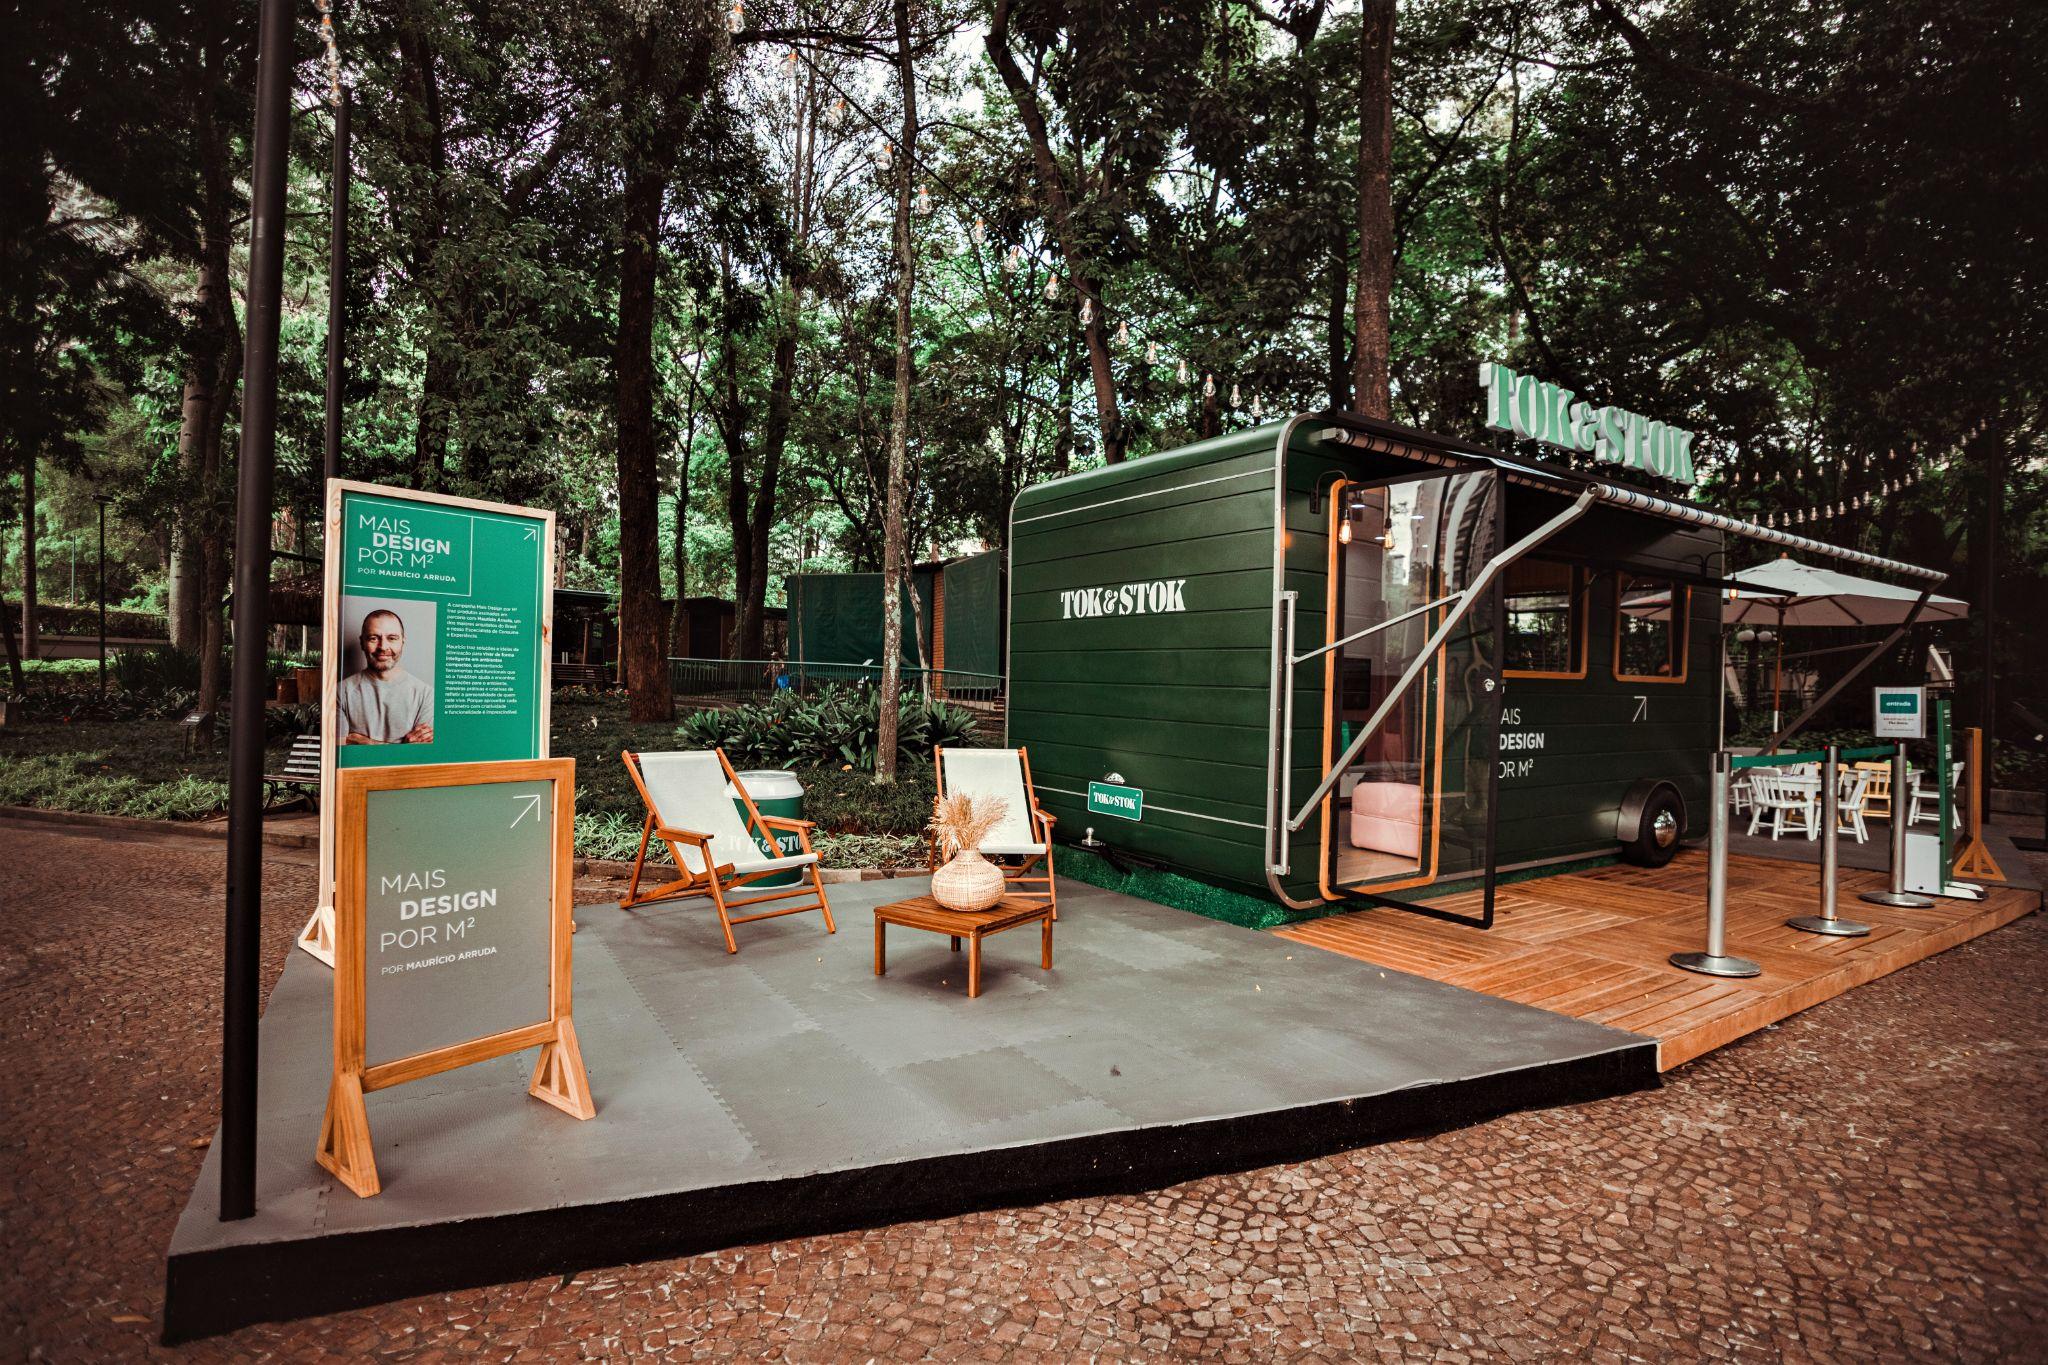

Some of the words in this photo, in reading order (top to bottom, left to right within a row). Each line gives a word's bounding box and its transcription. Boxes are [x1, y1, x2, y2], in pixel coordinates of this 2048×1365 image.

[1479, 362, 1695, 484] TOK&STOK
[359, 514, 411, 535] MAIS
[372, 532, 450, 555] DESIGN
[358, 547, 403, 567] POR
[410, 553, 434, 569] M²
[357, 567, 376, 575] POR
[378, 569, 421, 579] MAURÍCIO
[423, 573, 456, 582] ARRUDA
[1060, 579, 1186, 619] TOK&STOK
[1500, 708, 1521, 725] AIS
[1499, 732, 1545, 750] DESIGN
[1498, 761, 1515, 778] OR
[1518, 758, 1534, 777] M²
[1093, 791, 1136, 810] TOK&STOK
[381, 869, 446, 896] MAIS
[400, 888, 497, 921] DESIGN
[380, 925, 437, 953] POR
[446, 916, 475, 942] M²
[381, 964, 404, 976] POR
[406, 953, 456, 971] MAURÍCIO
[457, 946, 497, 961] ARRUDA
